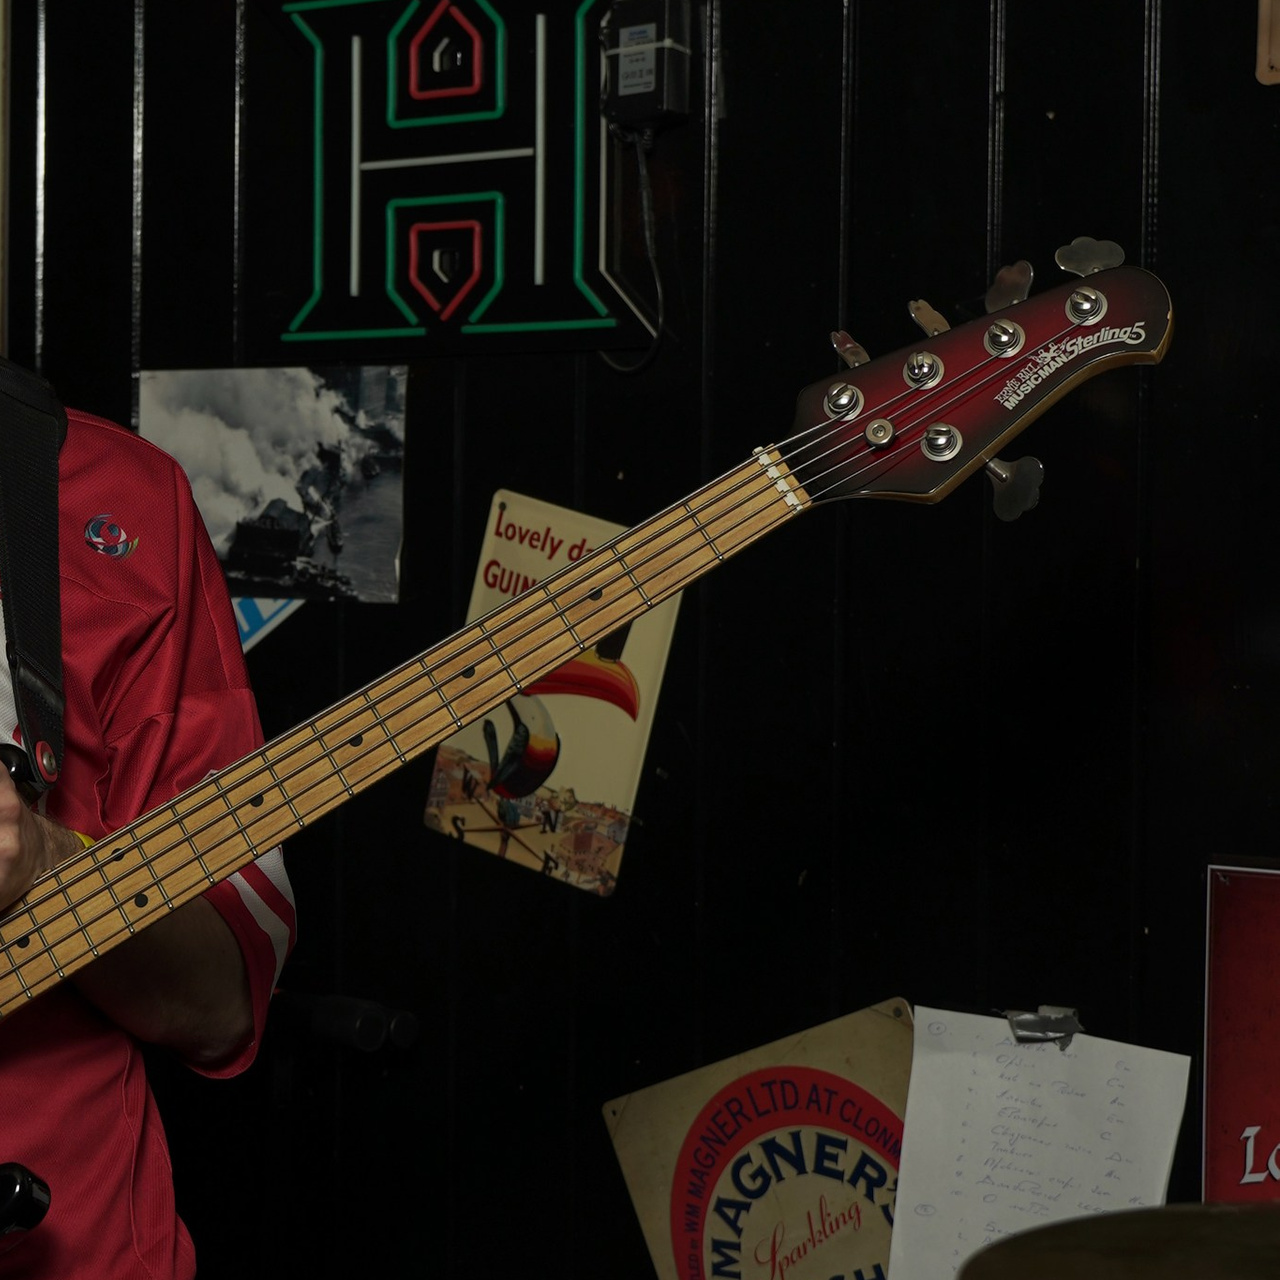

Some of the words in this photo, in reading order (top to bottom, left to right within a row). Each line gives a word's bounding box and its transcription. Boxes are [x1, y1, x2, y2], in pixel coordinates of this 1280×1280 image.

[495, 509, 564, 560] Lovely
[805, 1083, 839, 1116] AT
[687, 1096, 753, 1200] MAGNER
[684, 1203, 701, 1233] WM
